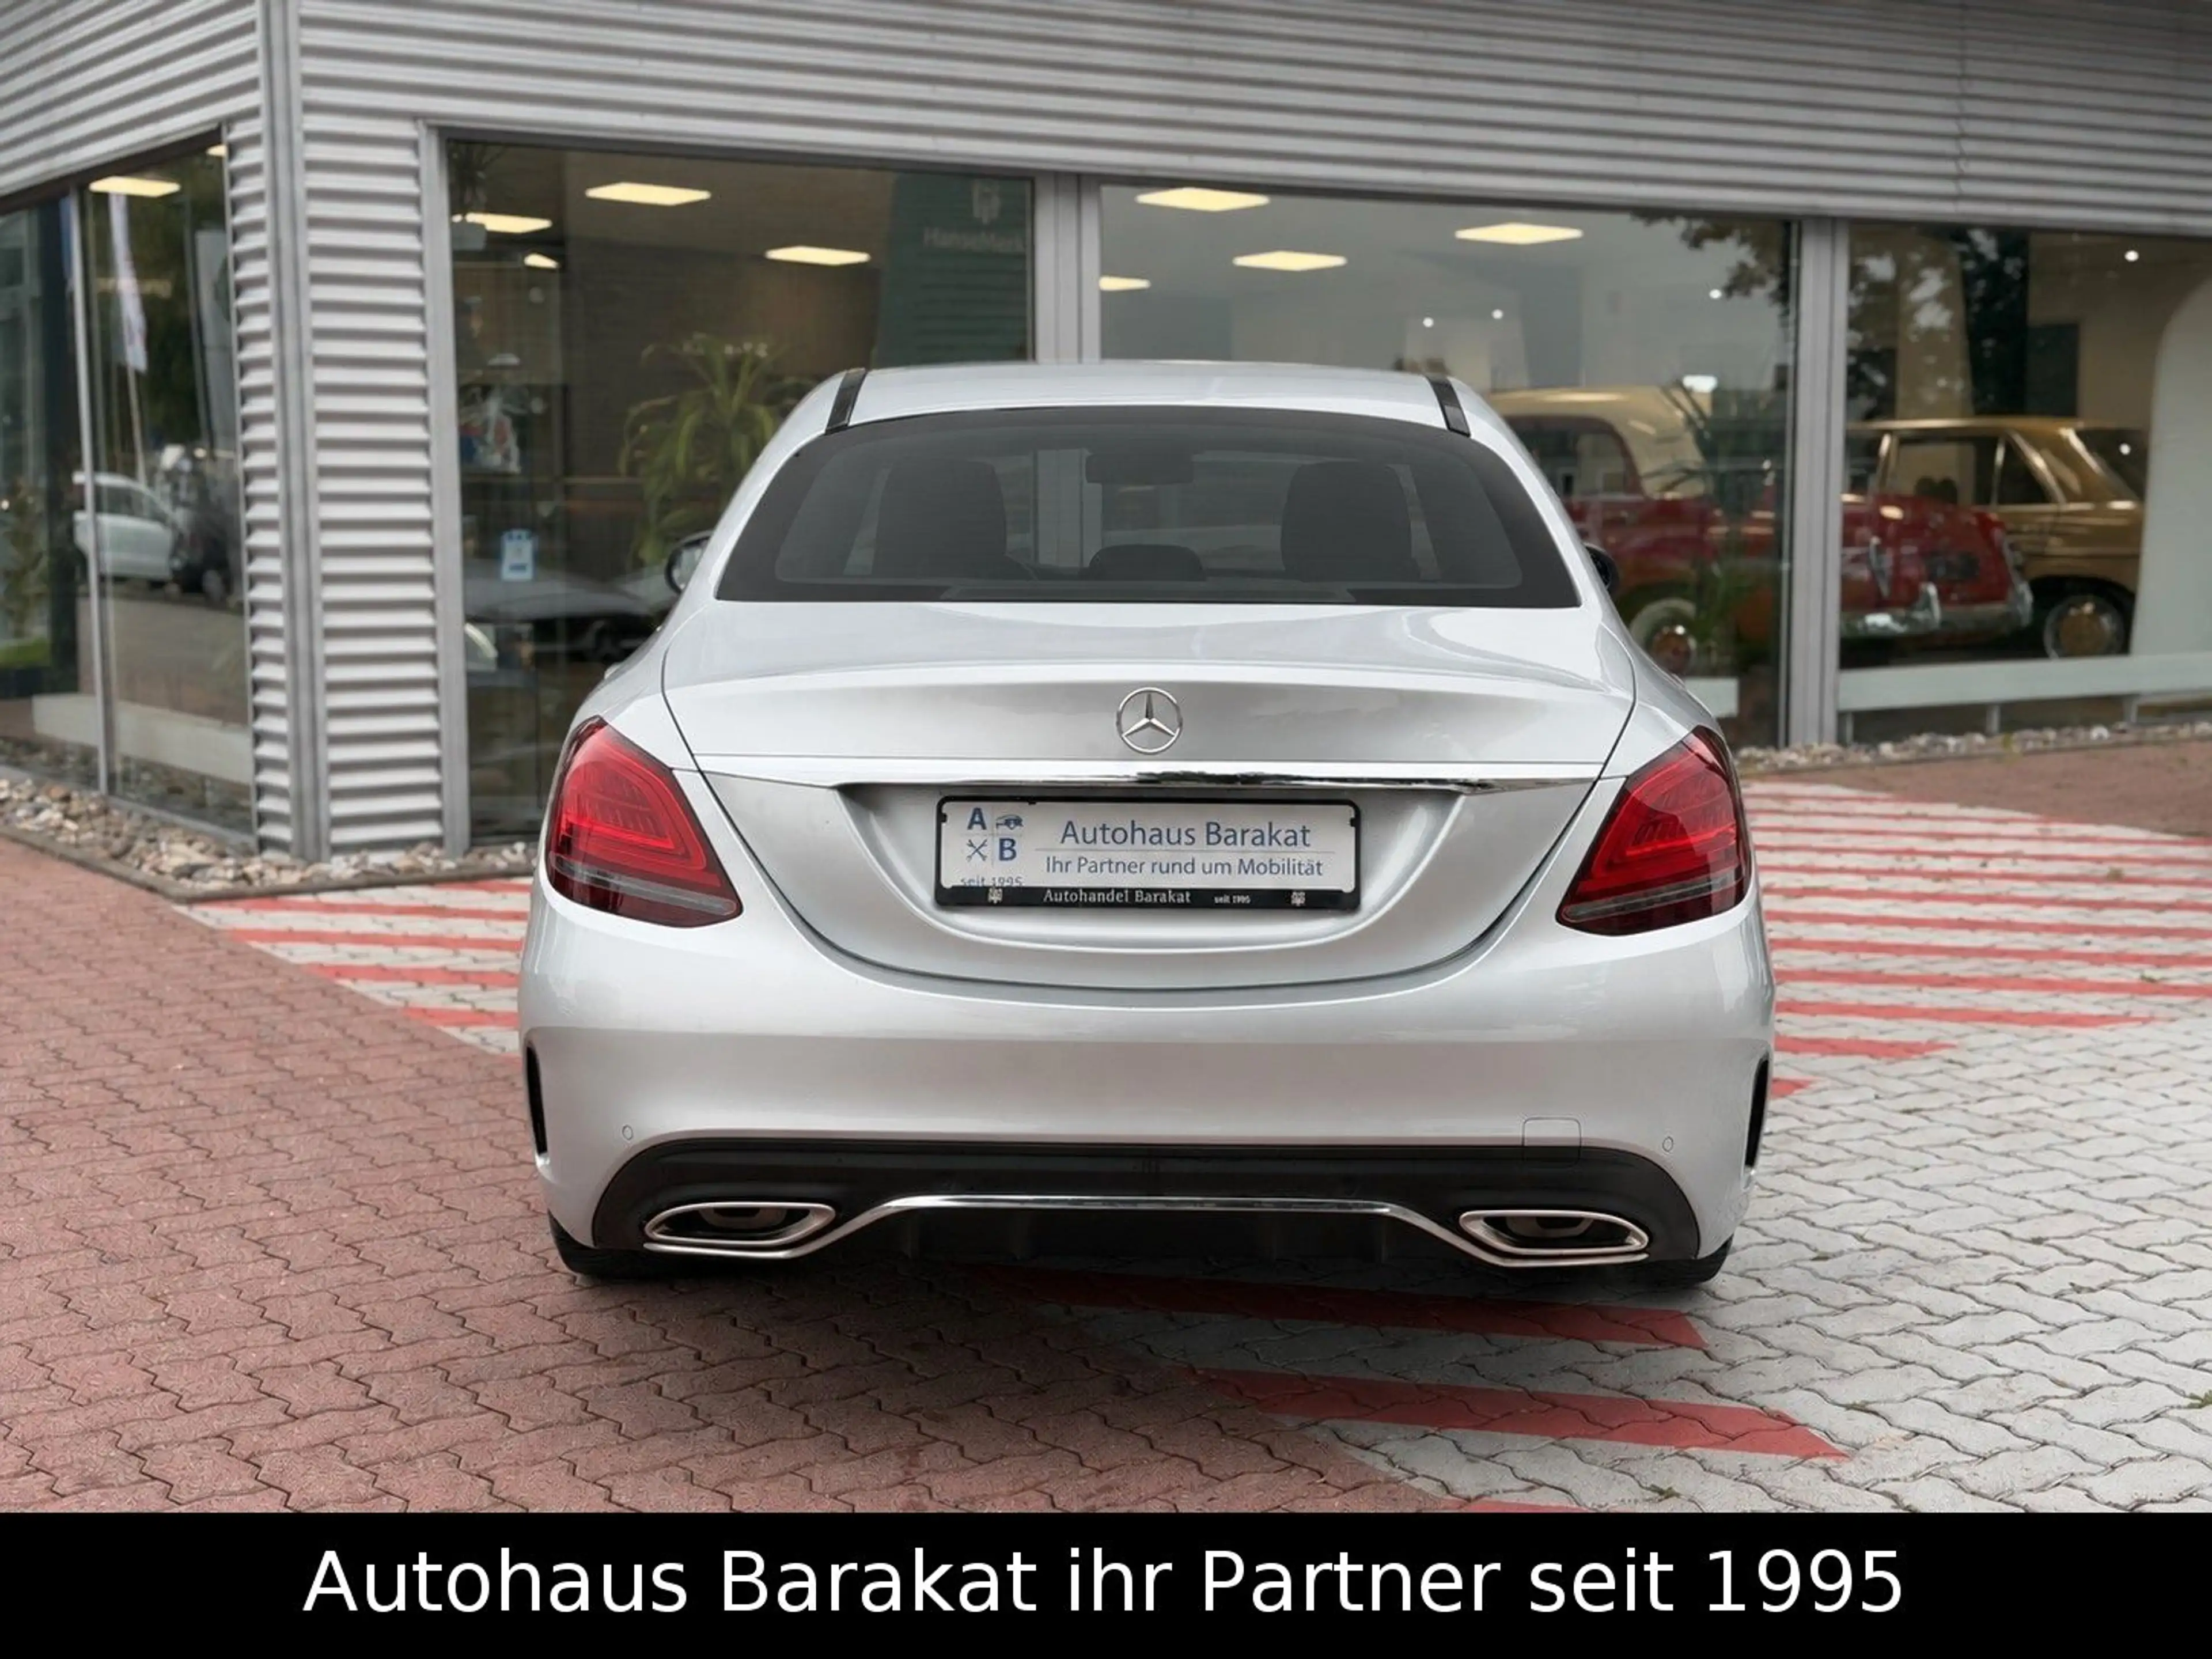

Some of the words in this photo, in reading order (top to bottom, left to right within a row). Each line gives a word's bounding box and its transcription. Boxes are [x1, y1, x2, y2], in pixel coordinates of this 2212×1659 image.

[967, 807, 987, 830] A
[1060, 820, 1196, 846] Autohaus
[1206, 822, 1310, 847] Barakat
[999, 838, 1017, 861] B
[1046, 856, 1072, 873] Ihr
[1077, 857, 1145, 873] Partner
[1152, 858, 1195, 874] rund
[1202, 862, 1232, 875] um
[1238, 858, 1323, 876] Mobilität
[1043, 889, 1128, 903] Autohandel
[1135, 891, 1191, 903] Barakat
